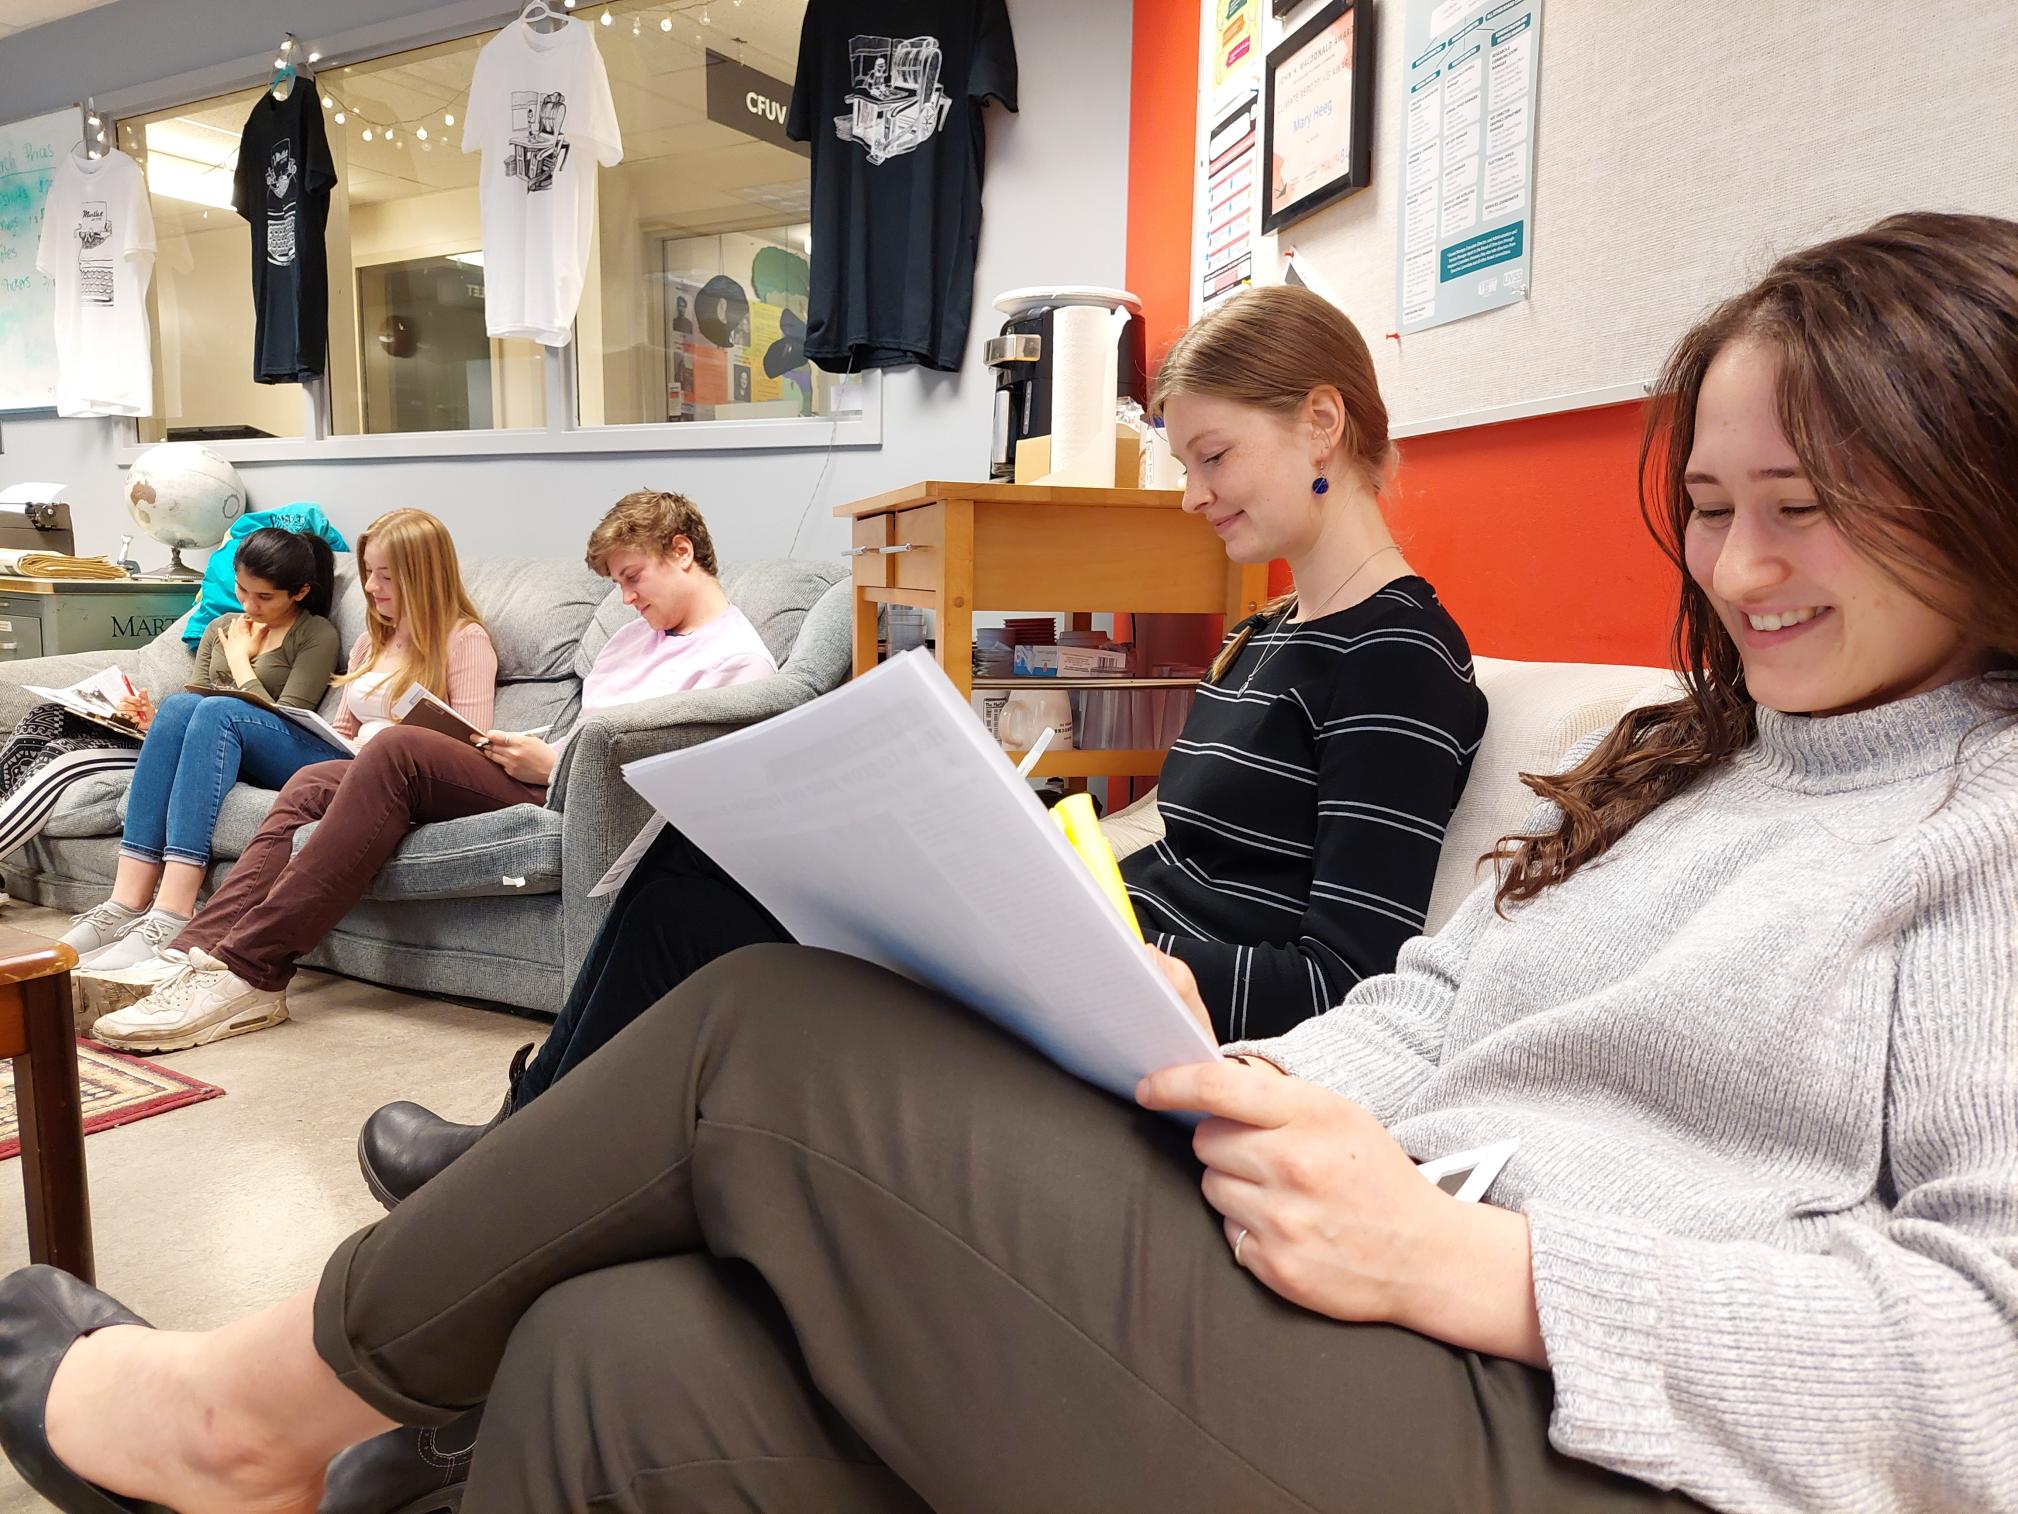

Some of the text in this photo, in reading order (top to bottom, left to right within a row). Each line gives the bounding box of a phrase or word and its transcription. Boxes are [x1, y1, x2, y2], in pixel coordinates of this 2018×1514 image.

[745, 91, 787, 125] CFUV
[1293, 99, 1333, 134] Mary Heeg
